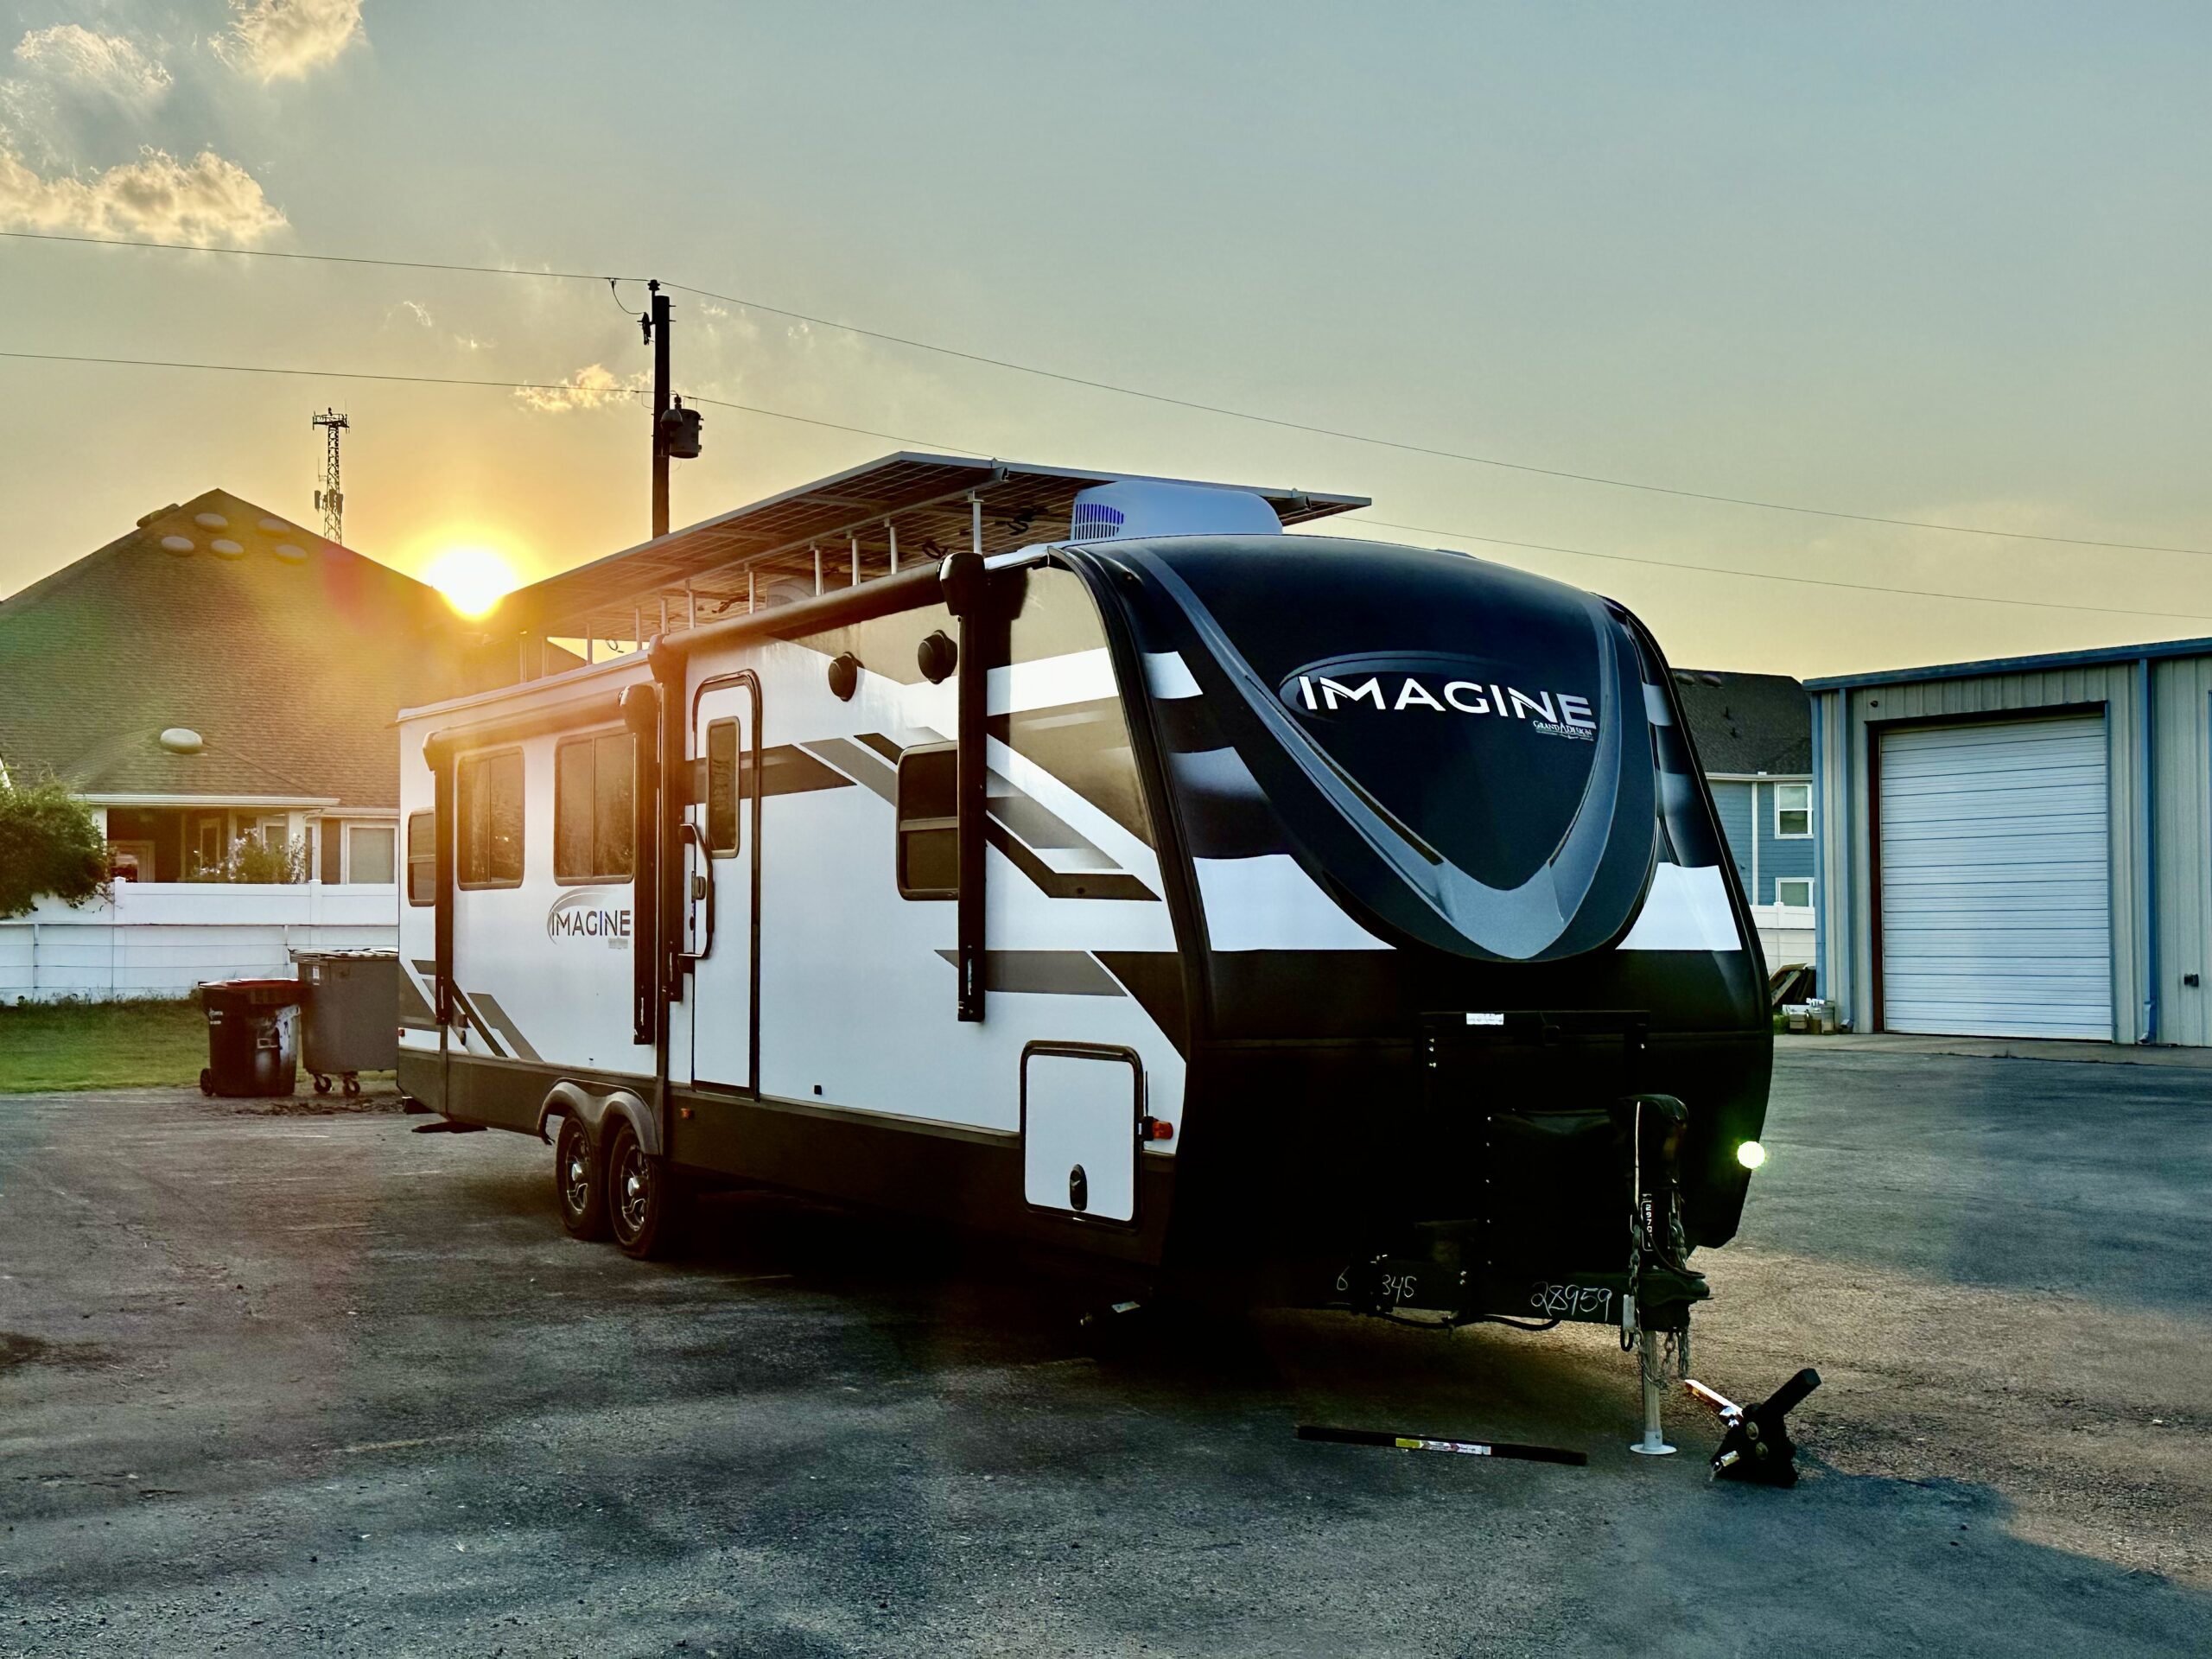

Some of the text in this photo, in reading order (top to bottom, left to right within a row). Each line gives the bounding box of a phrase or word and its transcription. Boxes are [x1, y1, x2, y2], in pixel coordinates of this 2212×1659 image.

[1298, 676, 1597, 729] IMAGINE
[550, 910, 631, 937] IMAGINE
[1530, 1281, 1612, 1322] 28959
